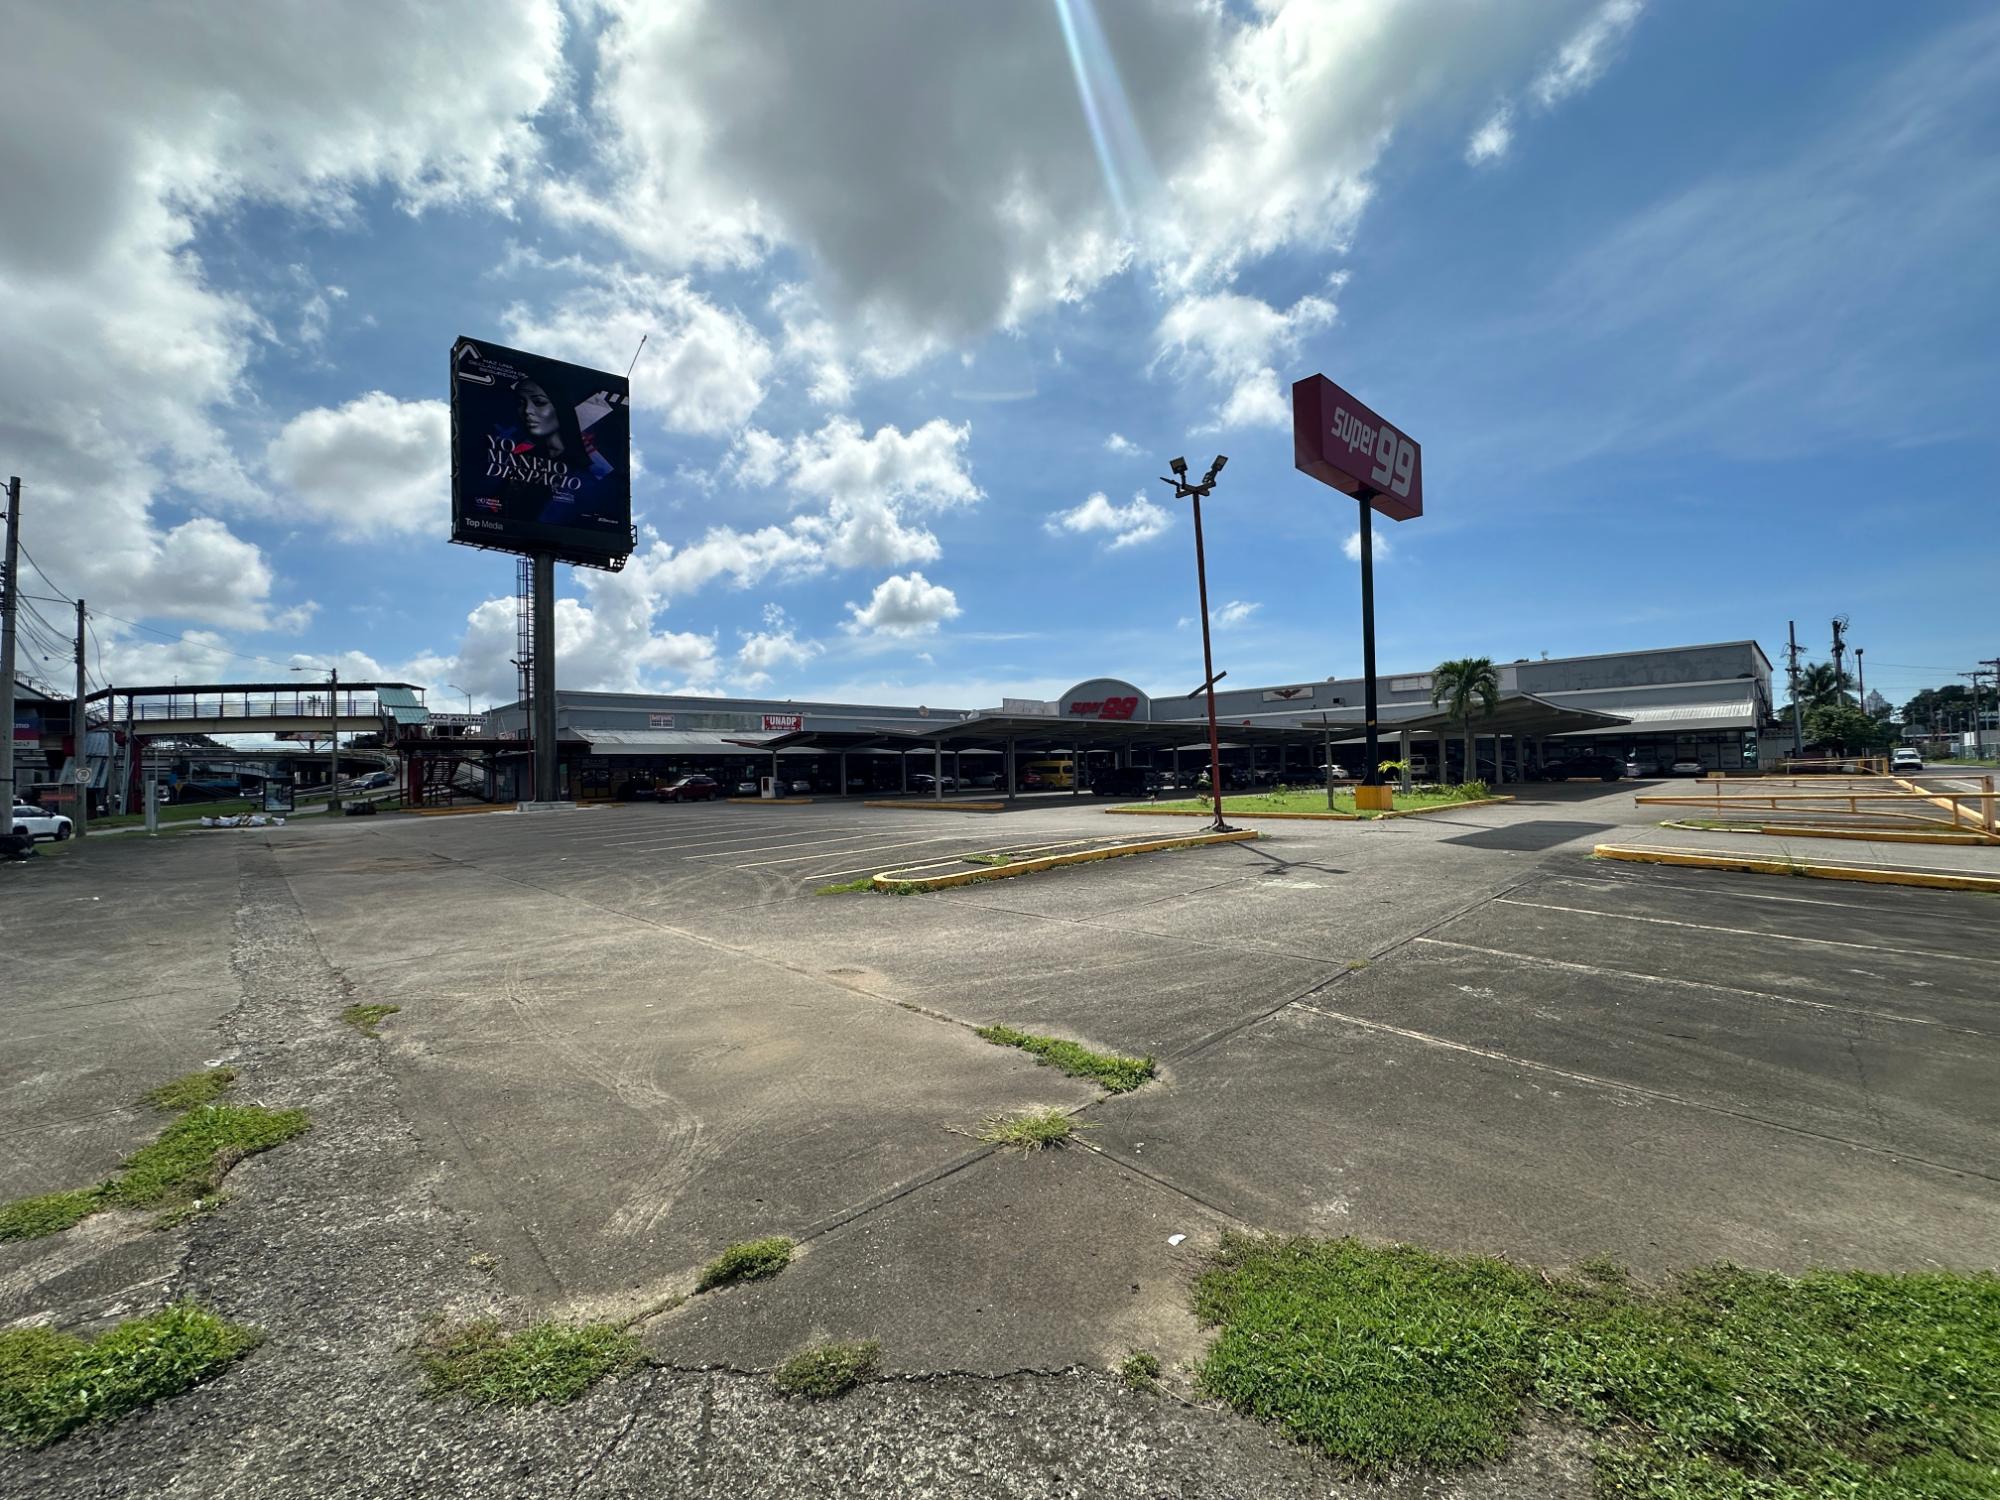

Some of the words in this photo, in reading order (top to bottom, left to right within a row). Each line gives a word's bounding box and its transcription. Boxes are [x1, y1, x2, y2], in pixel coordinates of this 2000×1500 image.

[487, 434, 515, 452] YO
[1331, 406, 1378, 457] super
[1371, 425, 1416, 497] 99
[487, 448, 568, 475] MANEJO
[486, 463, 582, 490] DESPACIO
[465, 517, 480, 529] Top
[481, 520, 504, 531] Media
[1098, 696, 1138, 720] 99
